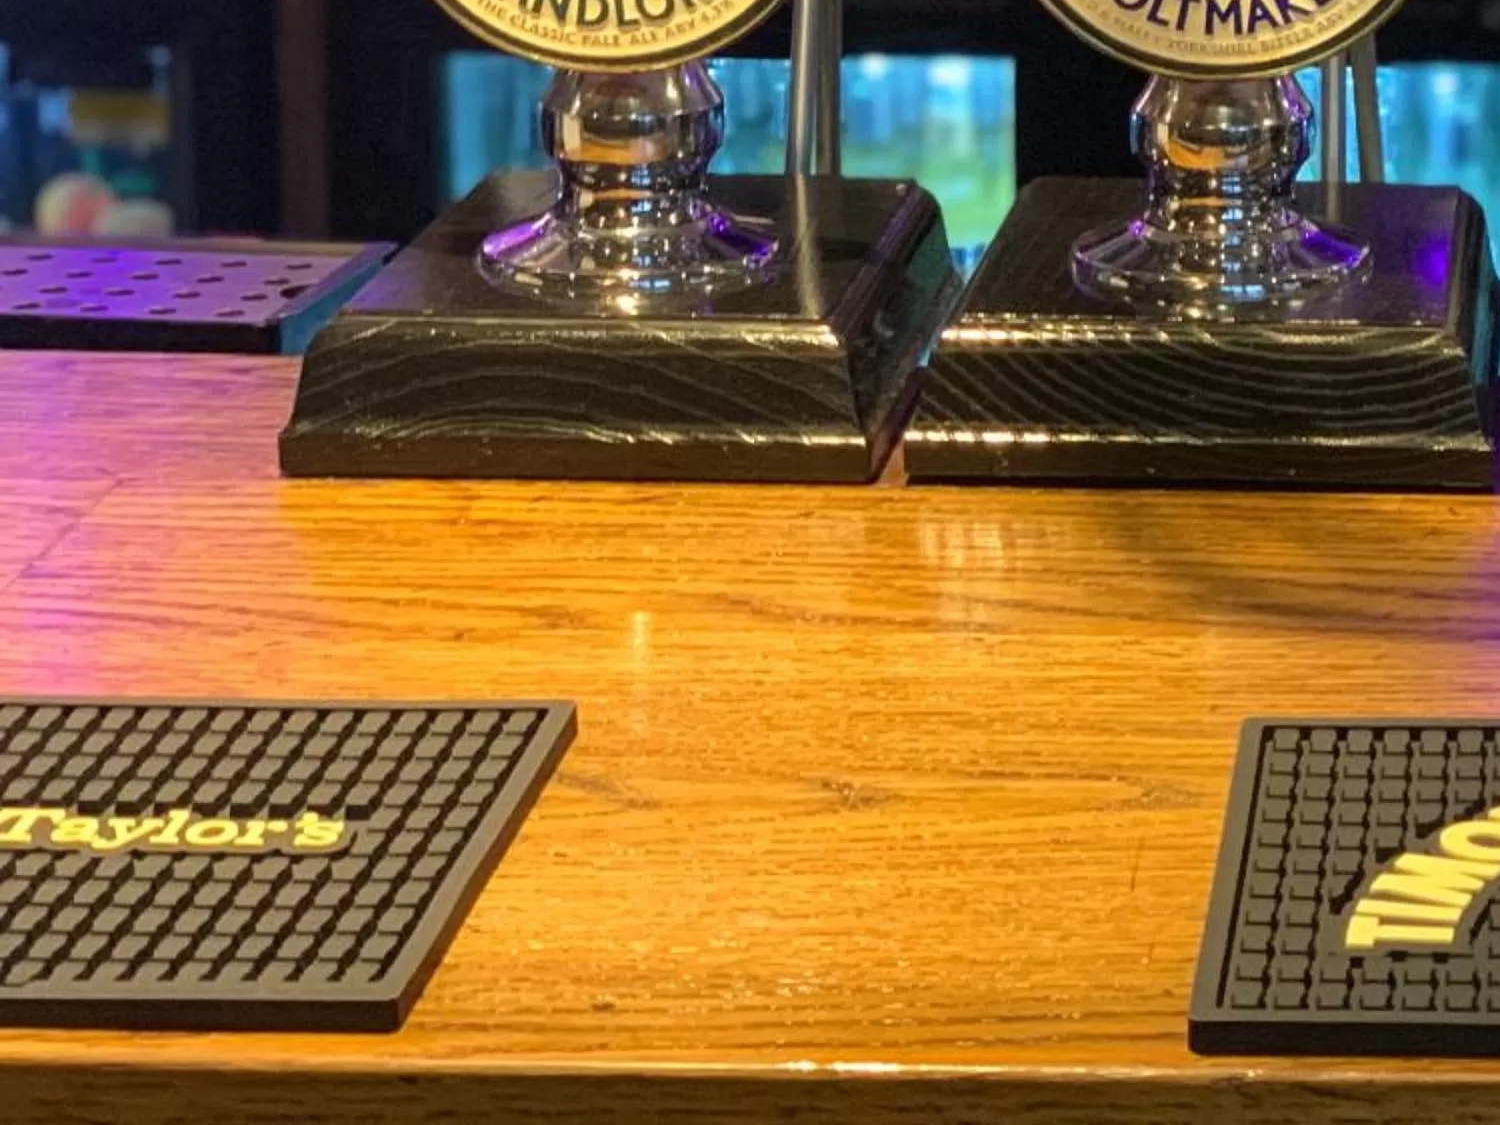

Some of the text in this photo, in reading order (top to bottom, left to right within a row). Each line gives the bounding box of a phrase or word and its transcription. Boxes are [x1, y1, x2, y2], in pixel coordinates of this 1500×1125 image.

[509, 14, 577, 45] CLASSIC
[582, 34, 621, 48] PALE
[629, 29, 658, 46] ALE
[0, 806, 345, 850] Taylor's
